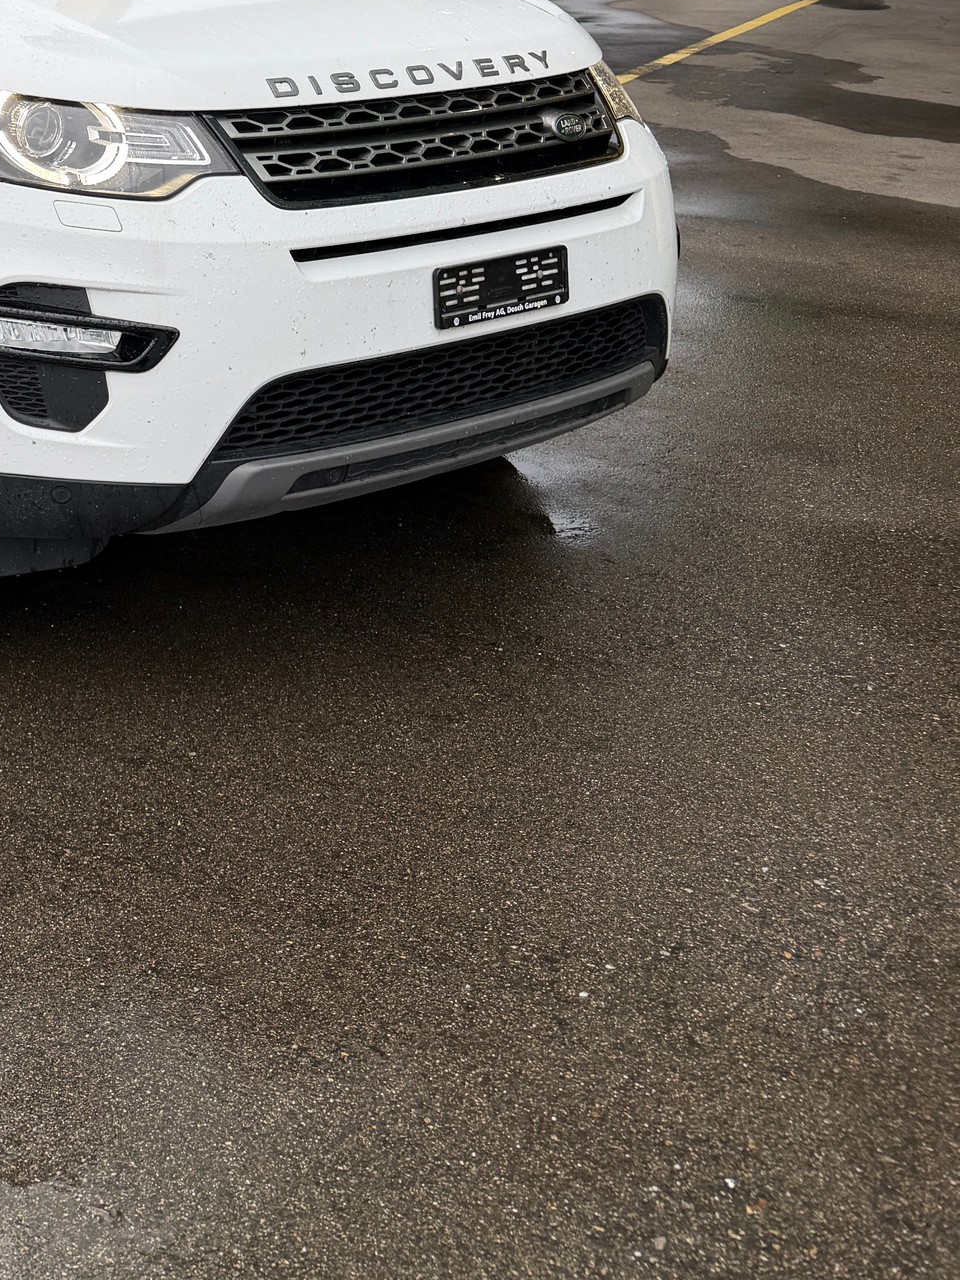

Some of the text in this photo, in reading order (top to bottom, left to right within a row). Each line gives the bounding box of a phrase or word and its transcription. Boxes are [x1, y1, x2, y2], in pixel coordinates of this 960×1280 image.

[265, 50, 551, 98] DISCOVERY
[468, 313, 482, 322] Emil
[482, 311, 495, 319] Frey
[495, 308, 506, 316] AG,
[524, 300, 548, 310] Garagen
